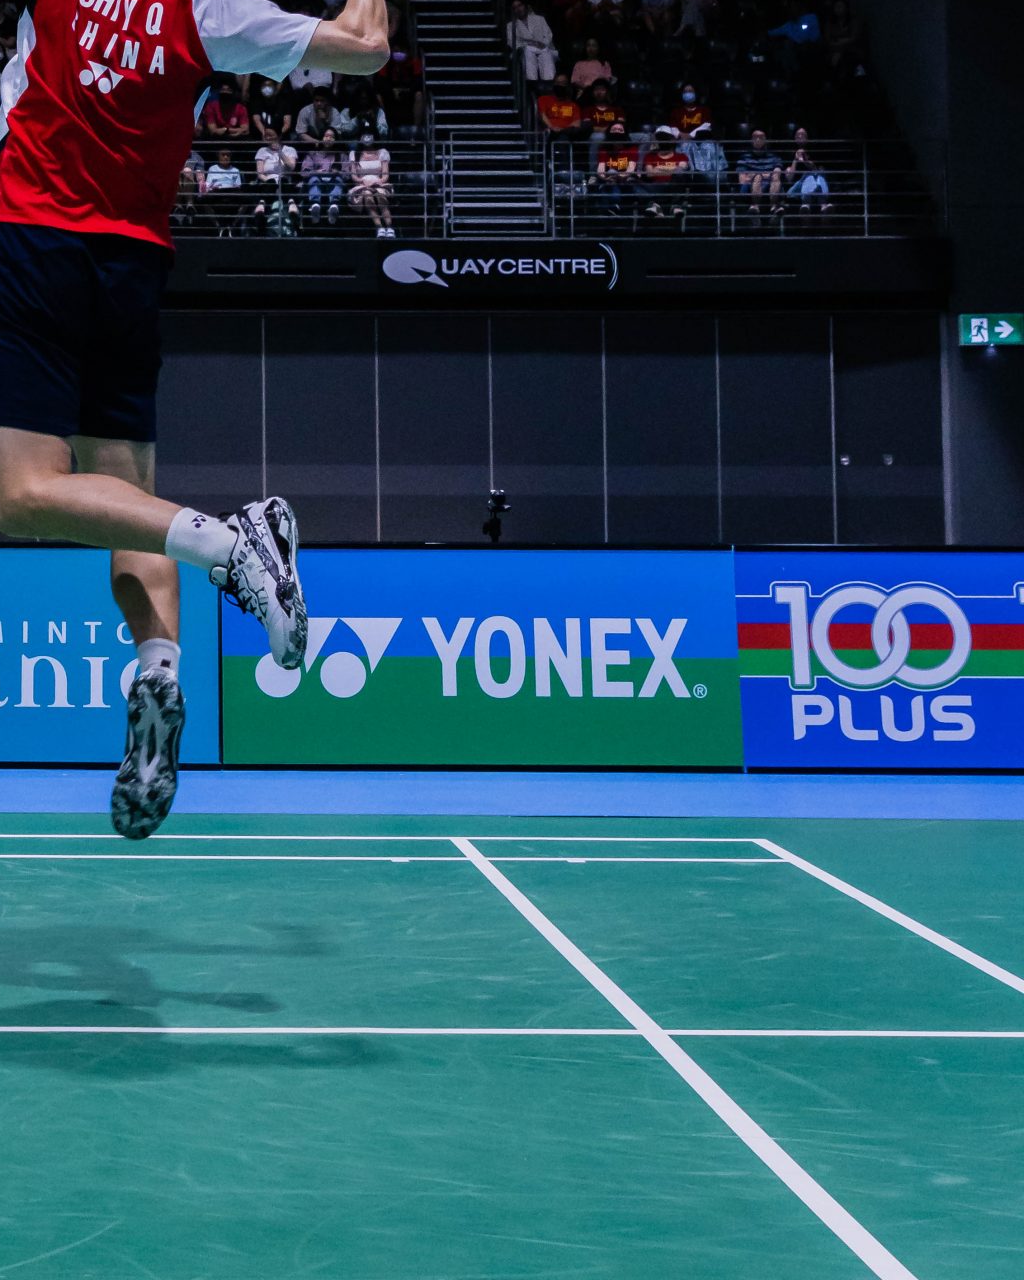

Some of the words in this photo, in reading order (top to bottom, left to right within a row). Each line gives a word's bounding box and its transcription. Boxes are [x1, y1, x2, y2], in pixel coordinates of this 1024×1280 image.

[72, 12, 165, 75] HINA
[145, 2, 164, 35] Q
[775, 586, 972, 686] 100
[791, 694, 976, 742] PLUS
